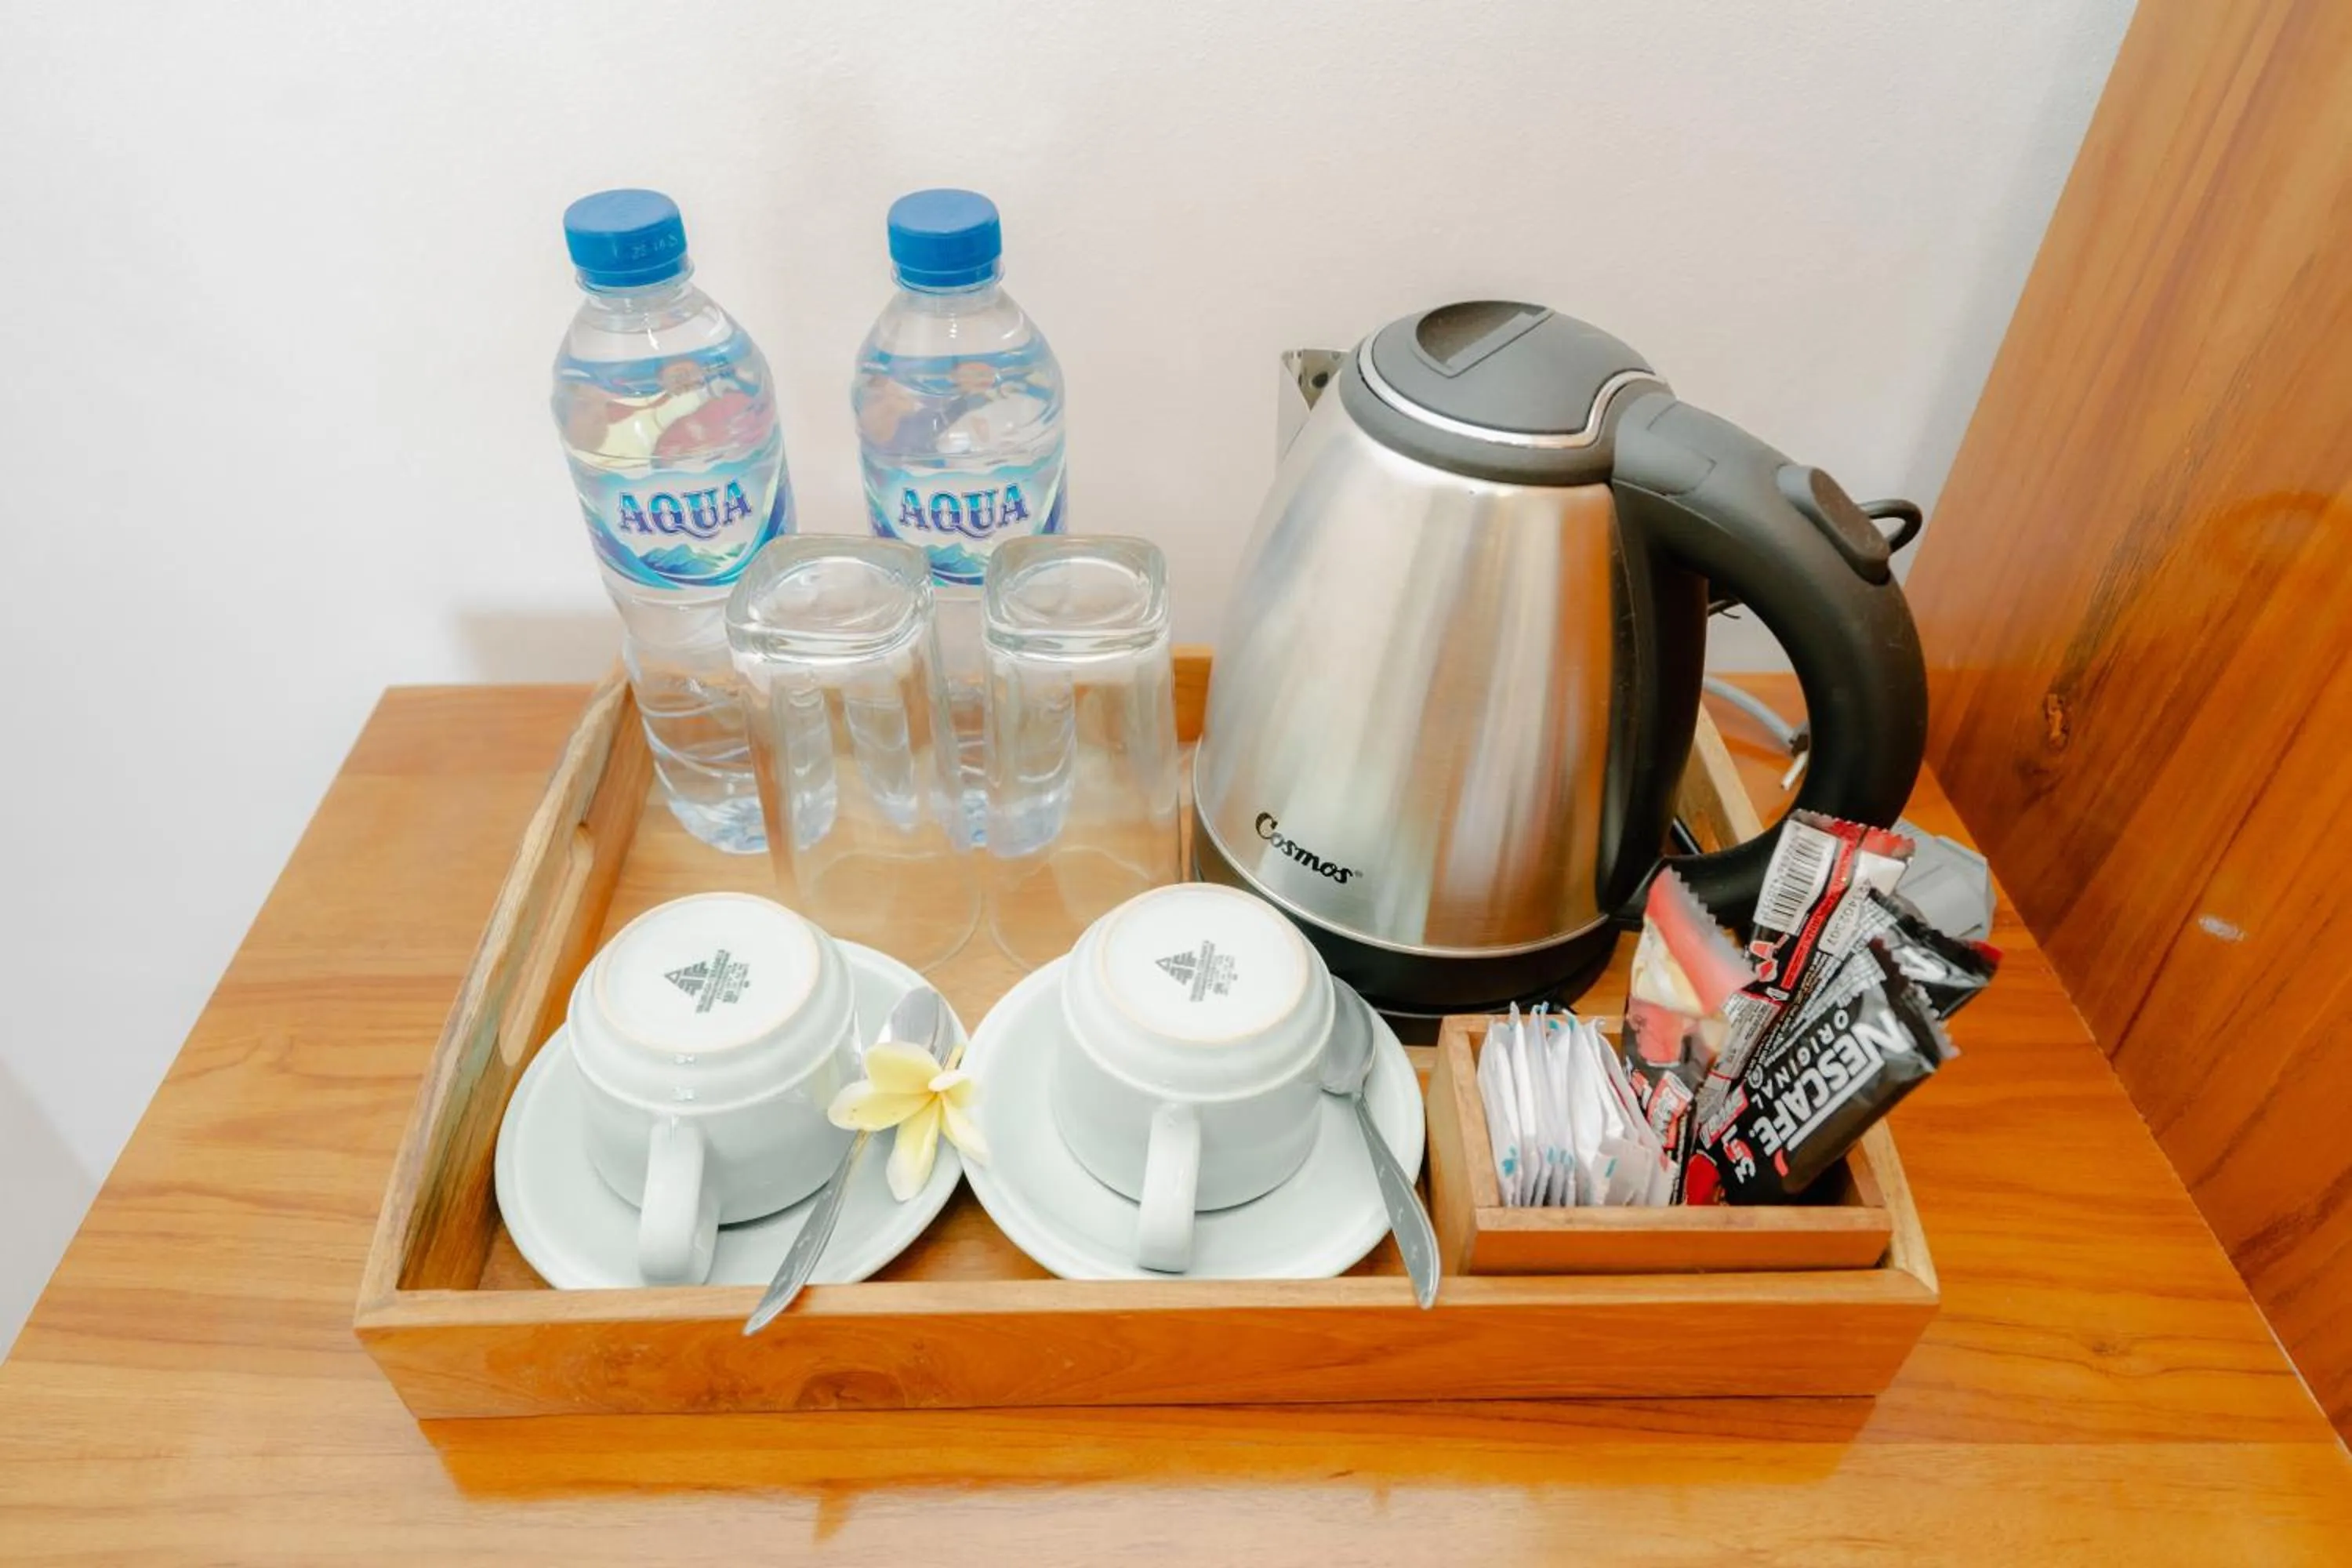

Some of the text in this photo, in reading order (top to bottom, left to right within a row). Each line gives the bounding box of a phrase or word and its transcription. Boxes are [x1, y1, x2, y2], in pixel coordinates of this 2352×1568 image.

[618, 481, 752, 539] AQUA
[898, 481, 1029, 539] AQUA
[1254, 811, 1354, 885] Cosmos
[1751, 1008, 1849, 1109] ORIGINAL
